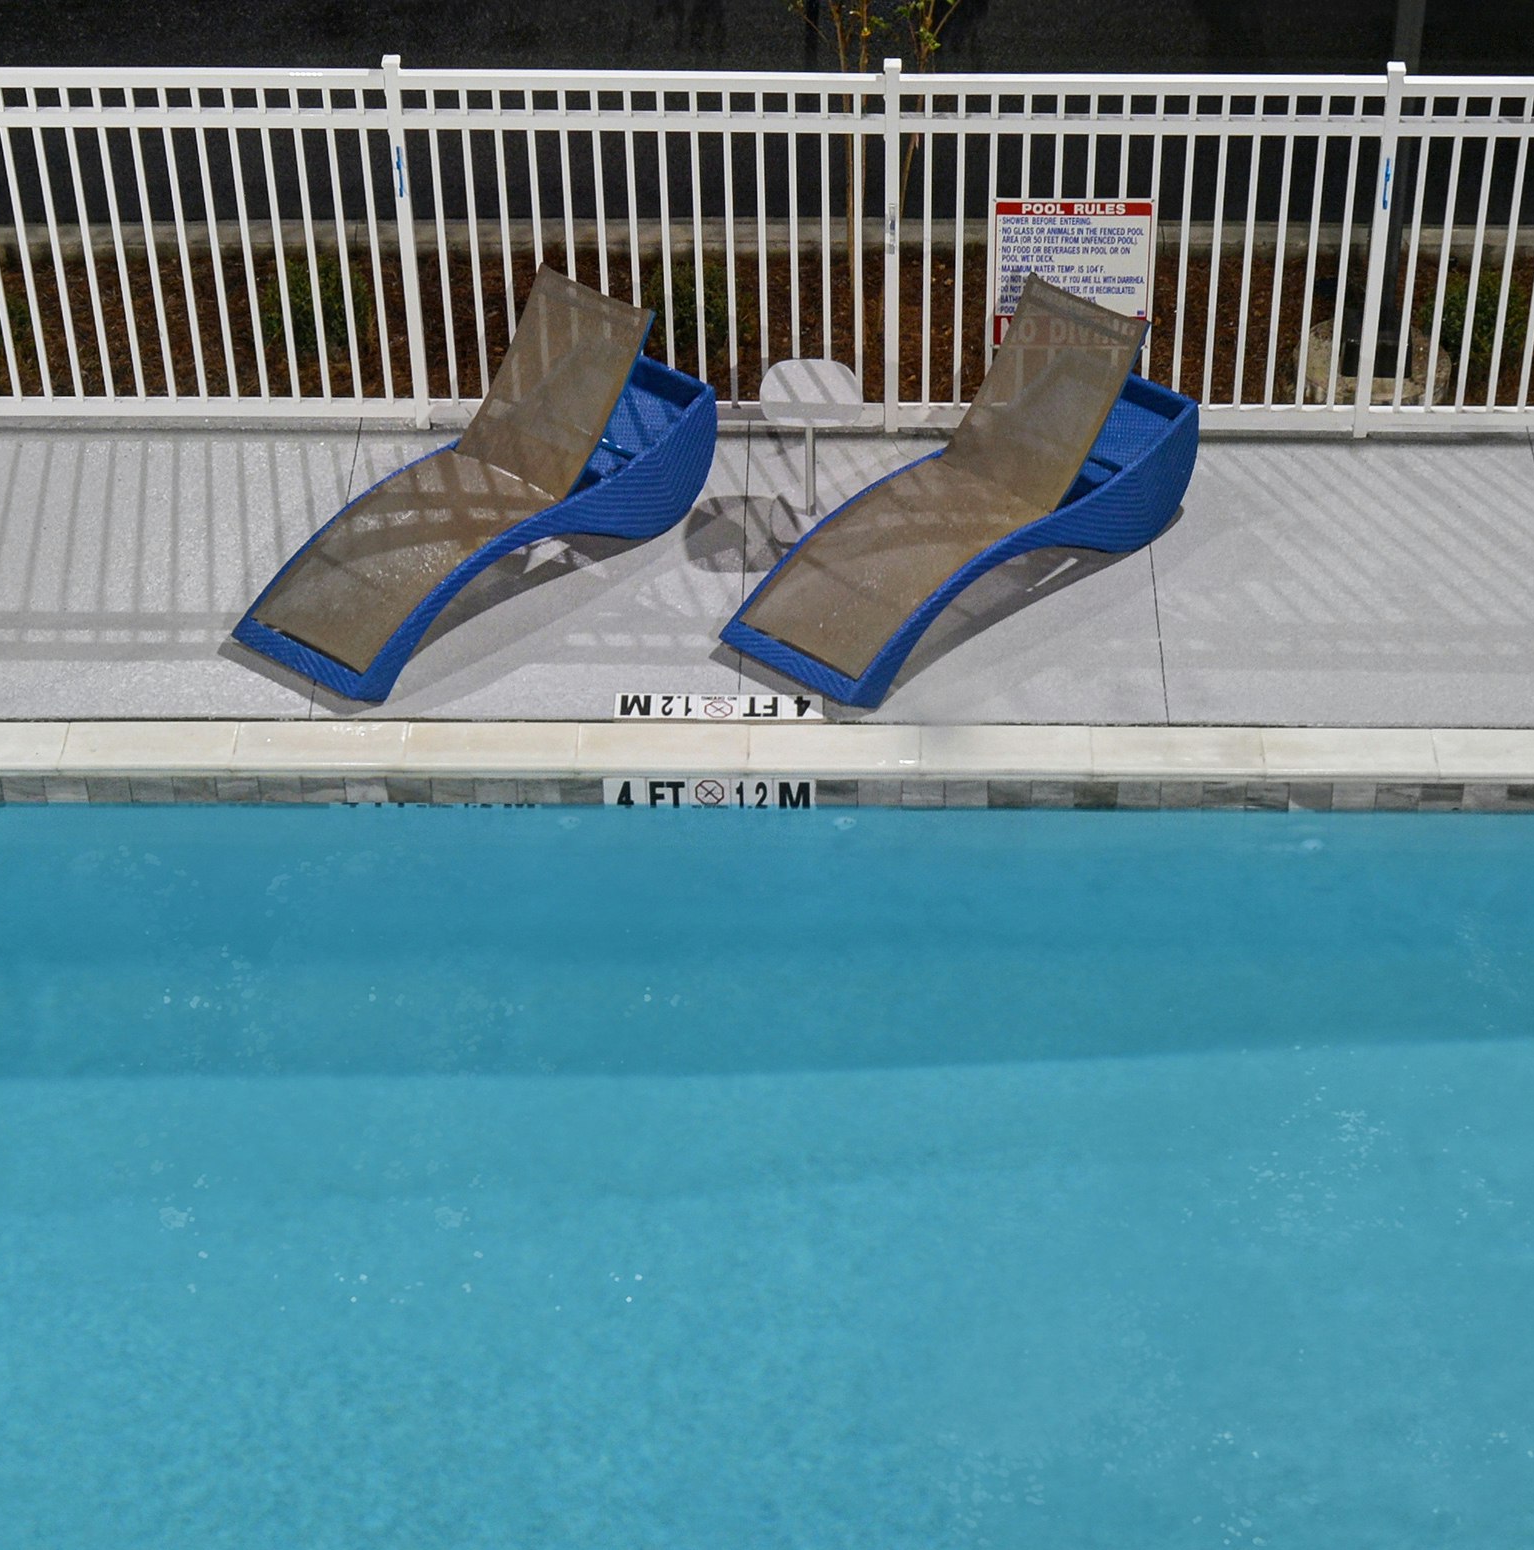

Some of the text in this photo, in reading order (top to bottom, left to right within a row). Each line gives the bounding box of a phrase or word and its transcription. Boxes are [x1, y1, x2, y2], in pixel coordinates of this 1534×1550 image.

[1022, 203, 1126, 215] POOL RULES
[1002, 217, 1057, 225] SHOWER BEFORE
[1002, 227, 1144, 235] NO GLASS OR ANIMALS IN THE FENCED POOL
[1002, 236, 1018, 244] AREA
[1034, 236, 1042, 244] 50
[1044, 236, 1059, 244] FEET
[1061, 236, 1079, 244] FROM
[1081, 236, 1115, 244] UNFENCED
[1002, 246, 1131, 254] NO FOOD OR BEVERAGES IN POOL OR ON
[1001, 265, 1032, 273] MAXIMUM
[1034, 265, 1055, 273] WATER
[1078, 265, 1084, 273] IS
[1001, 275, 1009, 283] DO
[1010, 275, 1022, 283] NOT
[1047, 275, 1060, 283] POOL
[1063, 275, 1068, 283] IF
[1069, 275, 1080, 283] YOU
[1082, 275, 1091, 283] ARE
[1103, 275, 1116, 283] WITH
[1010, 286, 1021, 294] NOT
[619, 695, 811, 717] 4 FT 1.2 M
[617, 781, 810, 809] 4 FT 1.2 M
